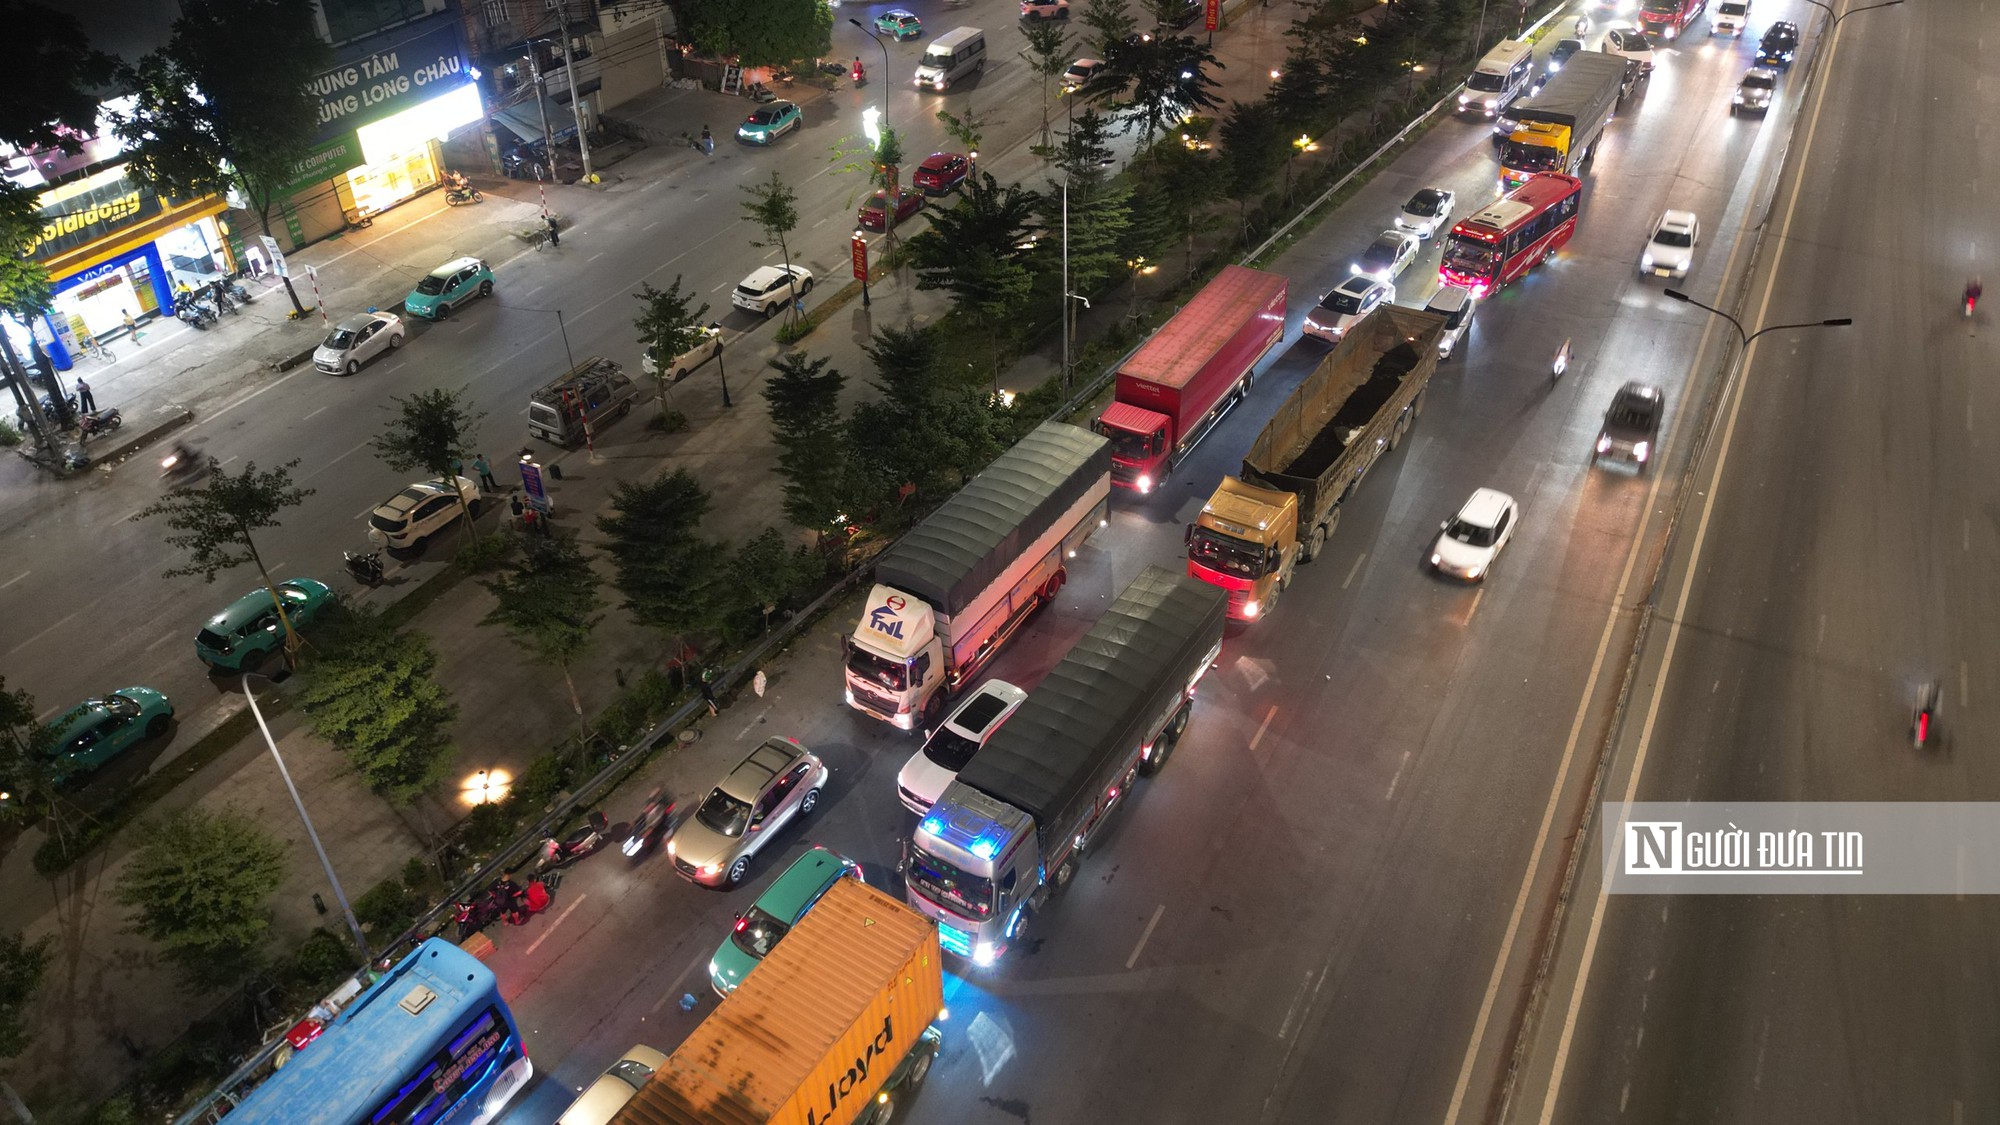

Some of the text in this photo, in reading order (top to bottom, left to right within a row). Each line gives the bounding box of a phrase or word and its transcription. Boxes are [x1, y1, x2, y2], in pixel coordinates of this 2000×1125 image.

[305, 52, 399, 97] RUNG TÂM
[317, 55, 460, 123] ỦNG LONG CHÂU
[305, 144, 347, 170] COMPUTER
[22, 191, 141, 258] gioididong
[1135, 382, 1161, 394] viettel
[870, 606, 904, 640] FNL
